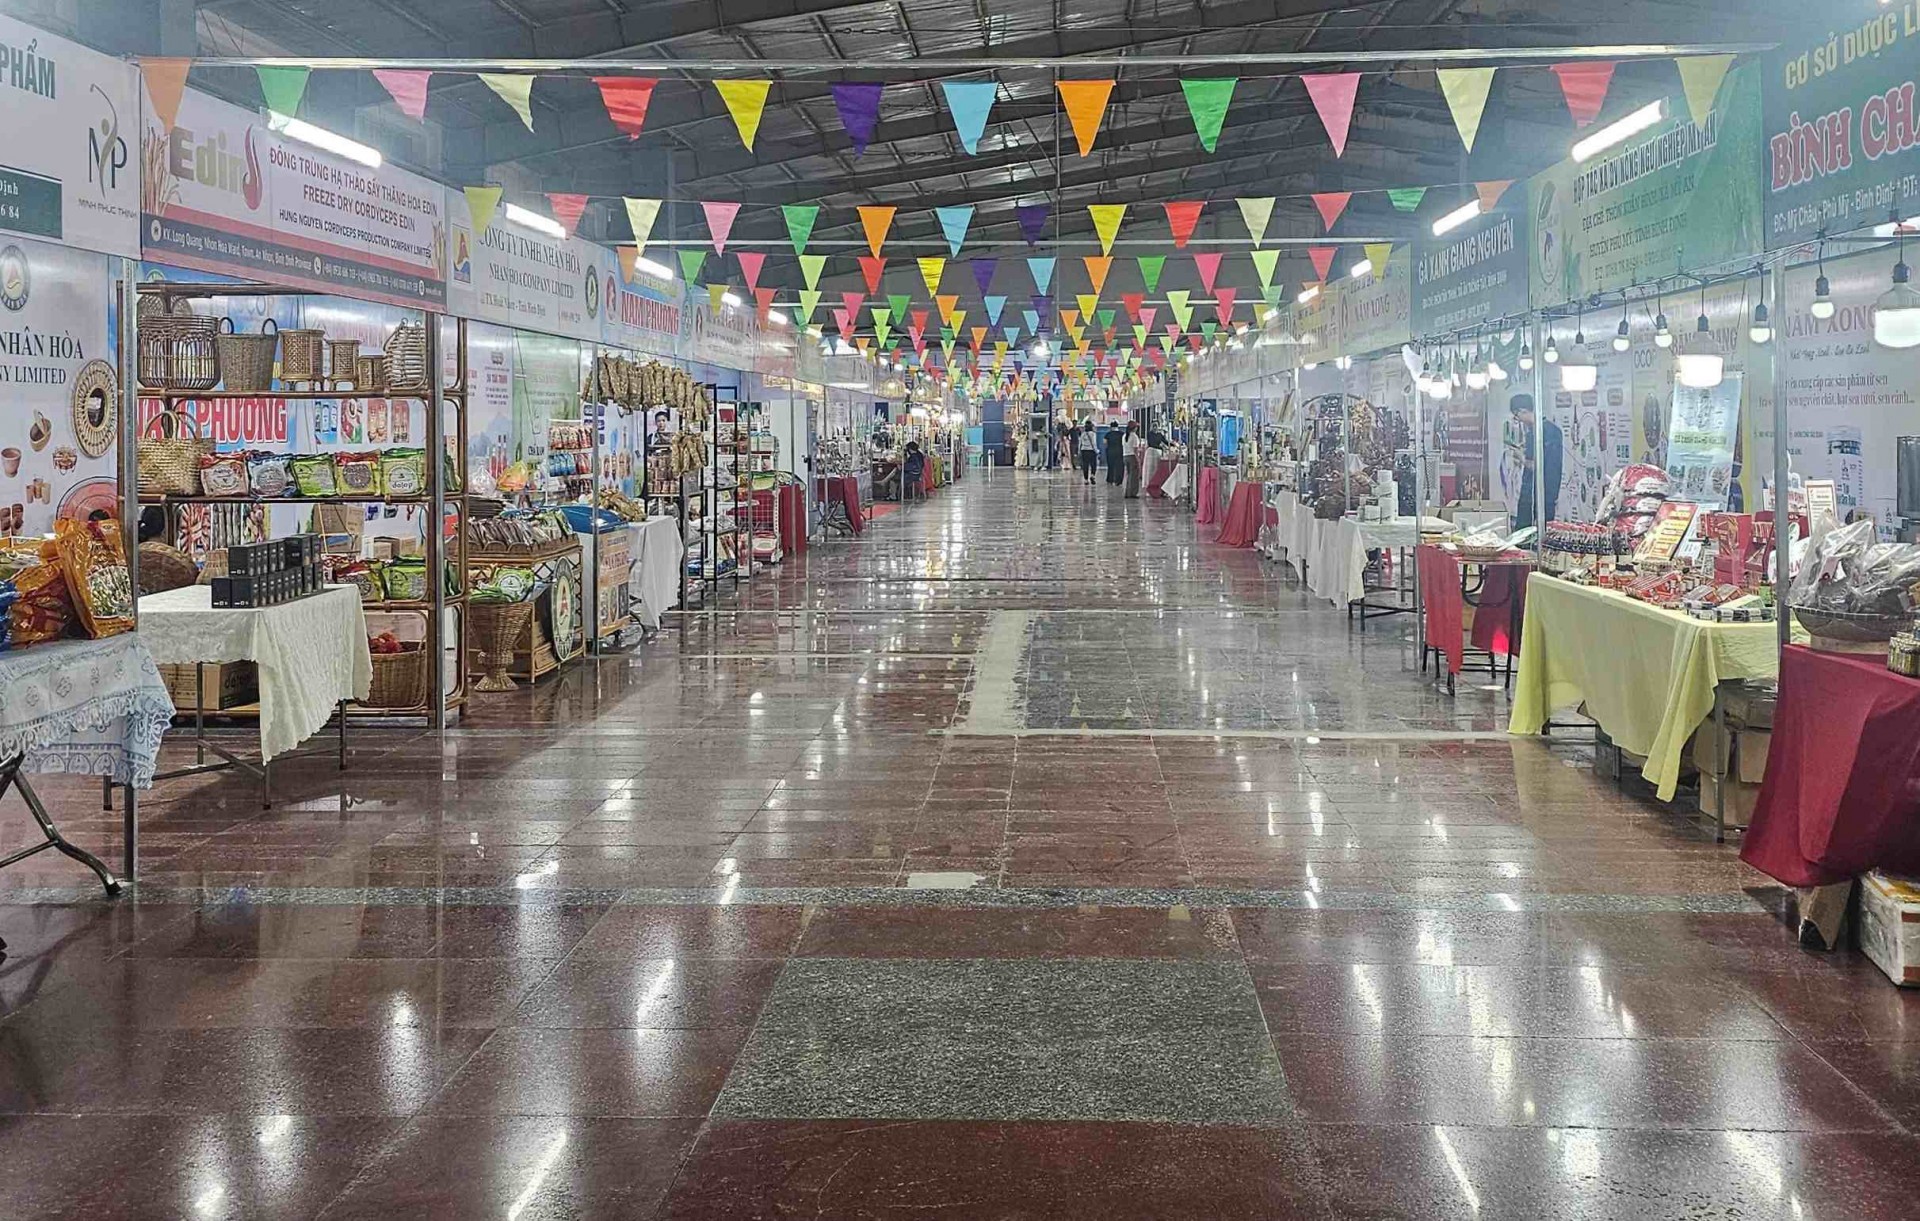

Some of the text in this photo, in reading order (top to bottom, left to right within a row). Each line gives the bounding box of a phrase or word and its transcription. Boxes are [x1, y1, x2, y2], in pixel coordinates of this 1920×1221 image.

[1785, 51, 1809, 90] CƠ
[1814, 31, 1838, 77] SỞ
[1843, 11, 1898, 65] DƯỢC
[1771, 111, 1852, 192] BÌNH
[270, 145, 297, 171] ĐÔNG
[299, 156, 329, 182] TRÙNG
[422, 199, 438, 218] EDIN
[1838, 193, 1849, 220] Mỹ
[1855, 187, 1875, 211] Bình
[1903, 174, 1918, 198] ĐT:
[8, 205, 20, 220] 84
[303, 184, 416, 232] FREEZE DRY CORDYCEPS EDIN
[172, 229, 185, 248] Long
[298, 213, 324, 231] NGUYEN
[324, 221, 357, 239] CORDYCEPS
[357, 229, 390, 248] PRODUCTION
[390, 238, 413, 254] COMPANY
[1429, 248, 1450, 283] XANH
[1450, 236, 1476, 273] GIANG
[49, 329, 84, 360] HÒA
[15, 365, 67, 385] LIMITED
